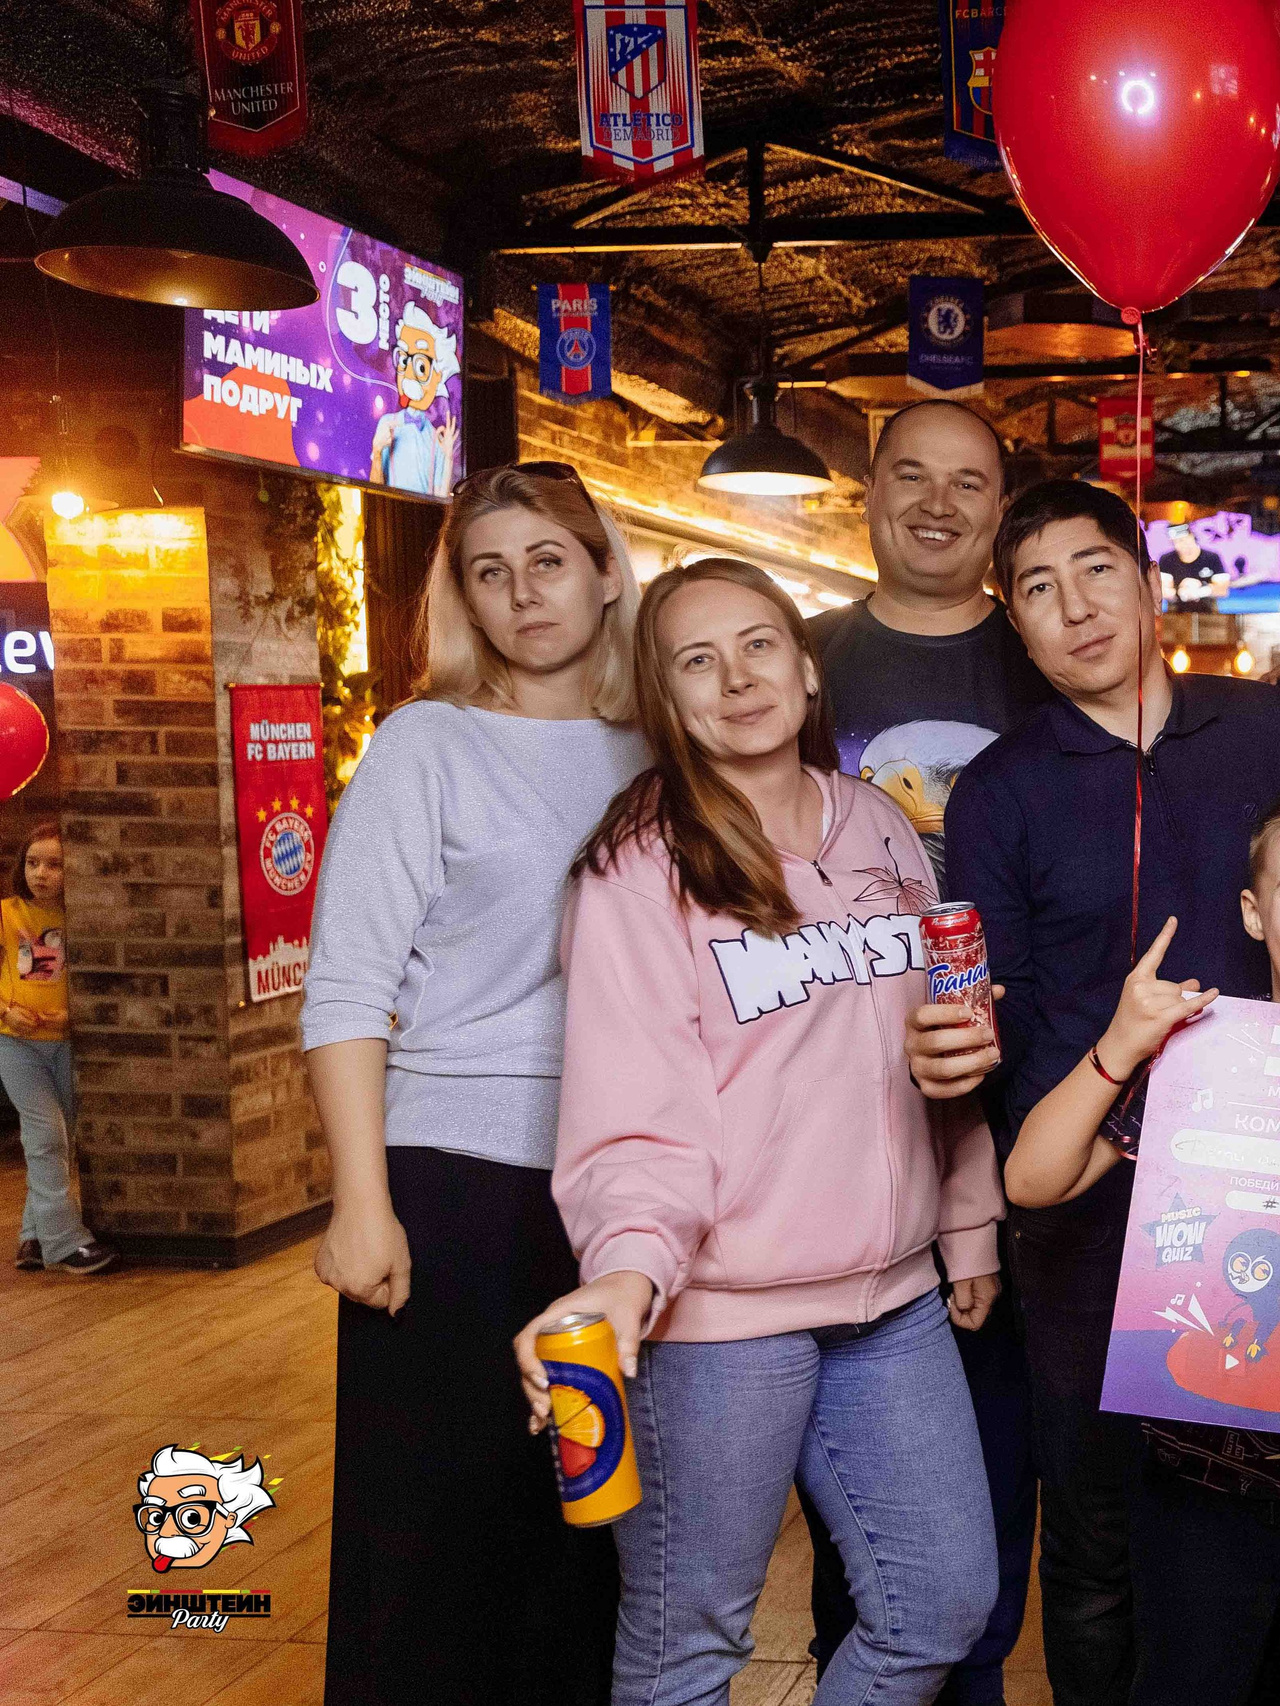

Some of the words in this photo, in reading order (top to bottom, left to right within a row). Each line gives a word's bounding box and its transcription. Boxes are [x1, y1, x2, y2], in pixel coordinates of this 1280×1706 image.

[214, 82, 294, 101] MANCHESTER
[231, 99, 278, 116] UNITED
[599, 110, 683, 127] ATLÉTICO
[336, 261, 378, 345] 3
[378, 273, 390, 350] МЕСТО
[551, 298, 598, 313] PARIS
[203, 331, 333, 393] МАМИНЫХ
[203, 374, 302, 422] ПОДРУГ
[250, 719, 312, 741] MÜNCHEN
[247, 742, 264, 761] FC
[266, 741, 316, 761] BAYERN
[257, 962, 307, 996] MÜNC
[1161, 1206, 1202, 1223] MUSIC
[1155, 1221, 1207, 1248] WOW
[1161, 1246, 1194, 1263] QUIZ
